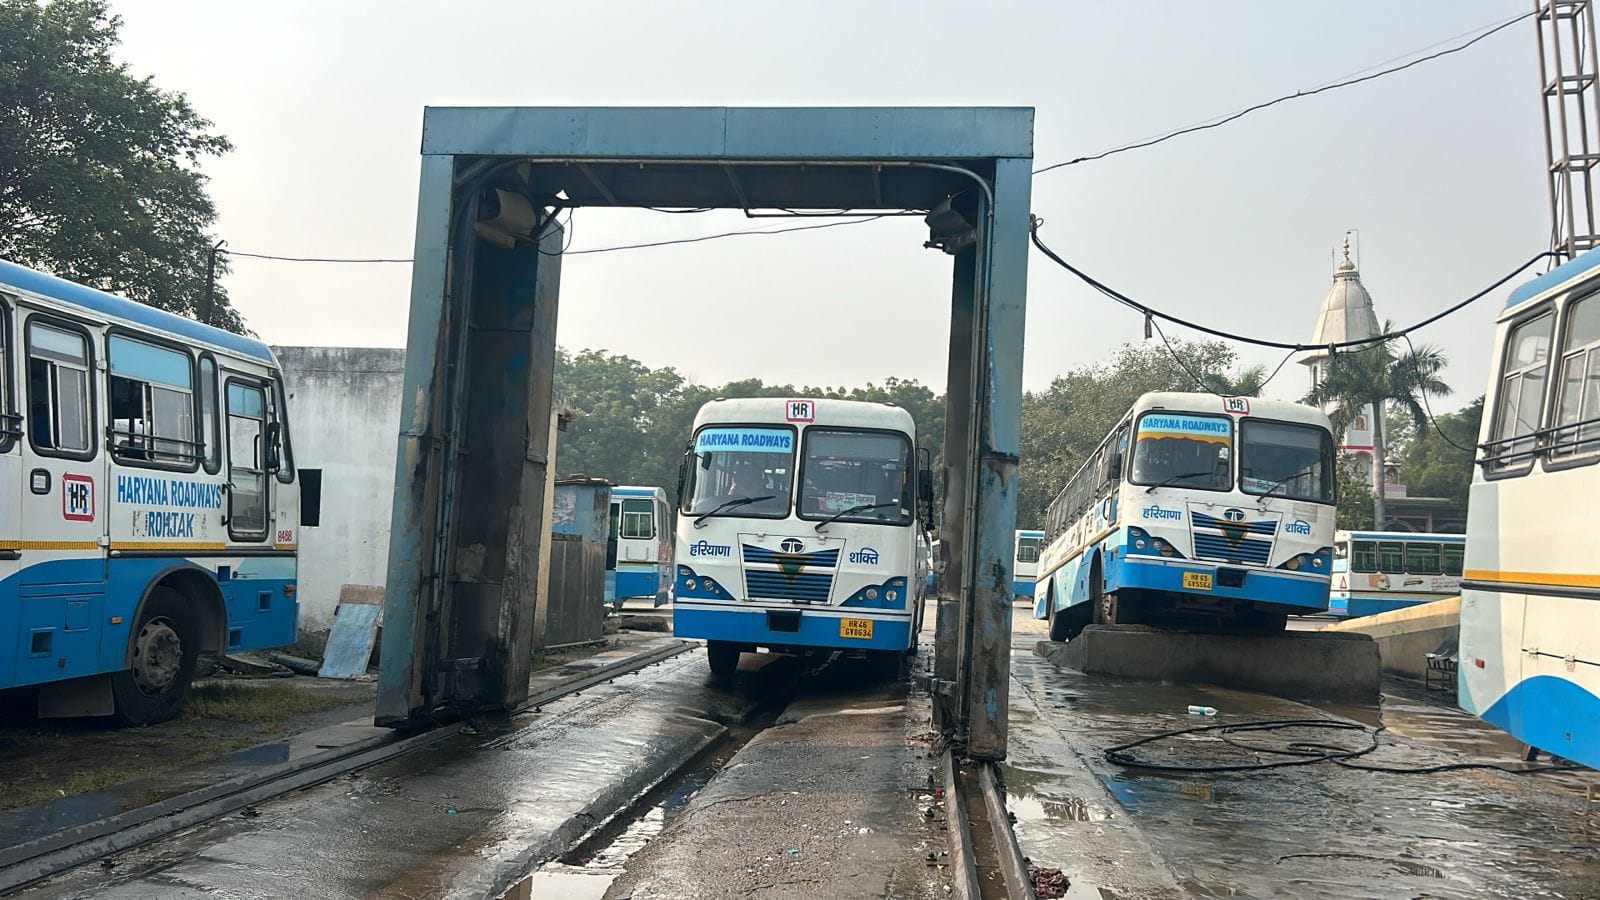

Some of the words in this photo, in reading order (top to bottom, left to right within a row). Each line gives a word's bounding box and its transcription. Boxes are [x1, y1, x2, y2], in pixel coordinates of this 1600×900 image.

[793, 403, 808, 415] HR
[1229, 399, 1244, 411] HR
[1142, 418, 1181, 430] HARYANA
[1182, 422, 1228, 433] ROADWAYS
[700, 433, 739, 447] HARYANA
[741, 434, 791, 448] ROADWAYS
[70, 483, 88, 510] HR
[117, 475, 168, 505] HARYANA
[171, 480, 222, 509] ROADWAYS
[1142, 505, 1182, 521] हरियाणा
[148, 511, 194, 538] ROHTAK
[1285, 520, 1311, 536] शक्ति
[690, 540, 731, 558] हरियाणा
[849, 547, 880, 566] शक्ति
[848, 620, 858, 628] HR
[858, 620, 867, 629] 46
